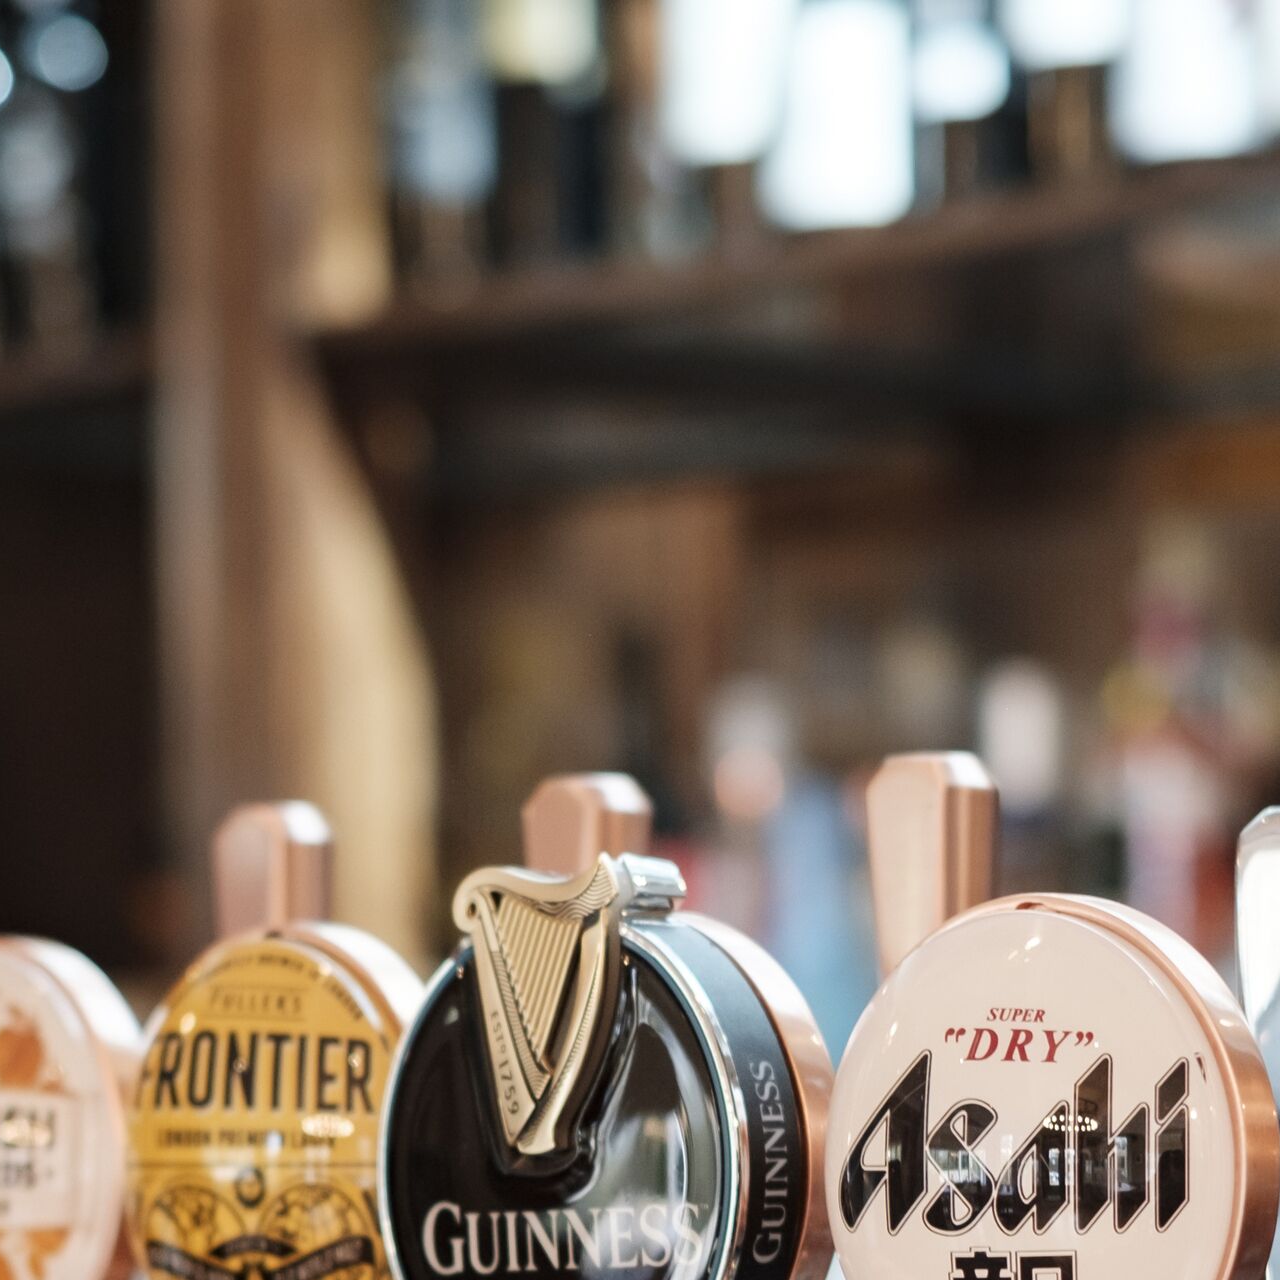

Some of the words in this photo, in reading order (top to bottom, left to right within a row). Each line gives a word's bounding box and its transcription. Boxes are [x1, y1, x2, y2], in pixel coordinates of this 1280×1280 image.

[986, 1006, 1046, 1023] SUPER
[135, 1029, 375, 1114] FRONTIER
[499, 1059, 520, 1115] 1759
[751, 1061, 789, 1264] GUINNESS
[838, 1048, 1191, 1237] Asahi
[422, 1200, 704, 1276] GUINNESS
